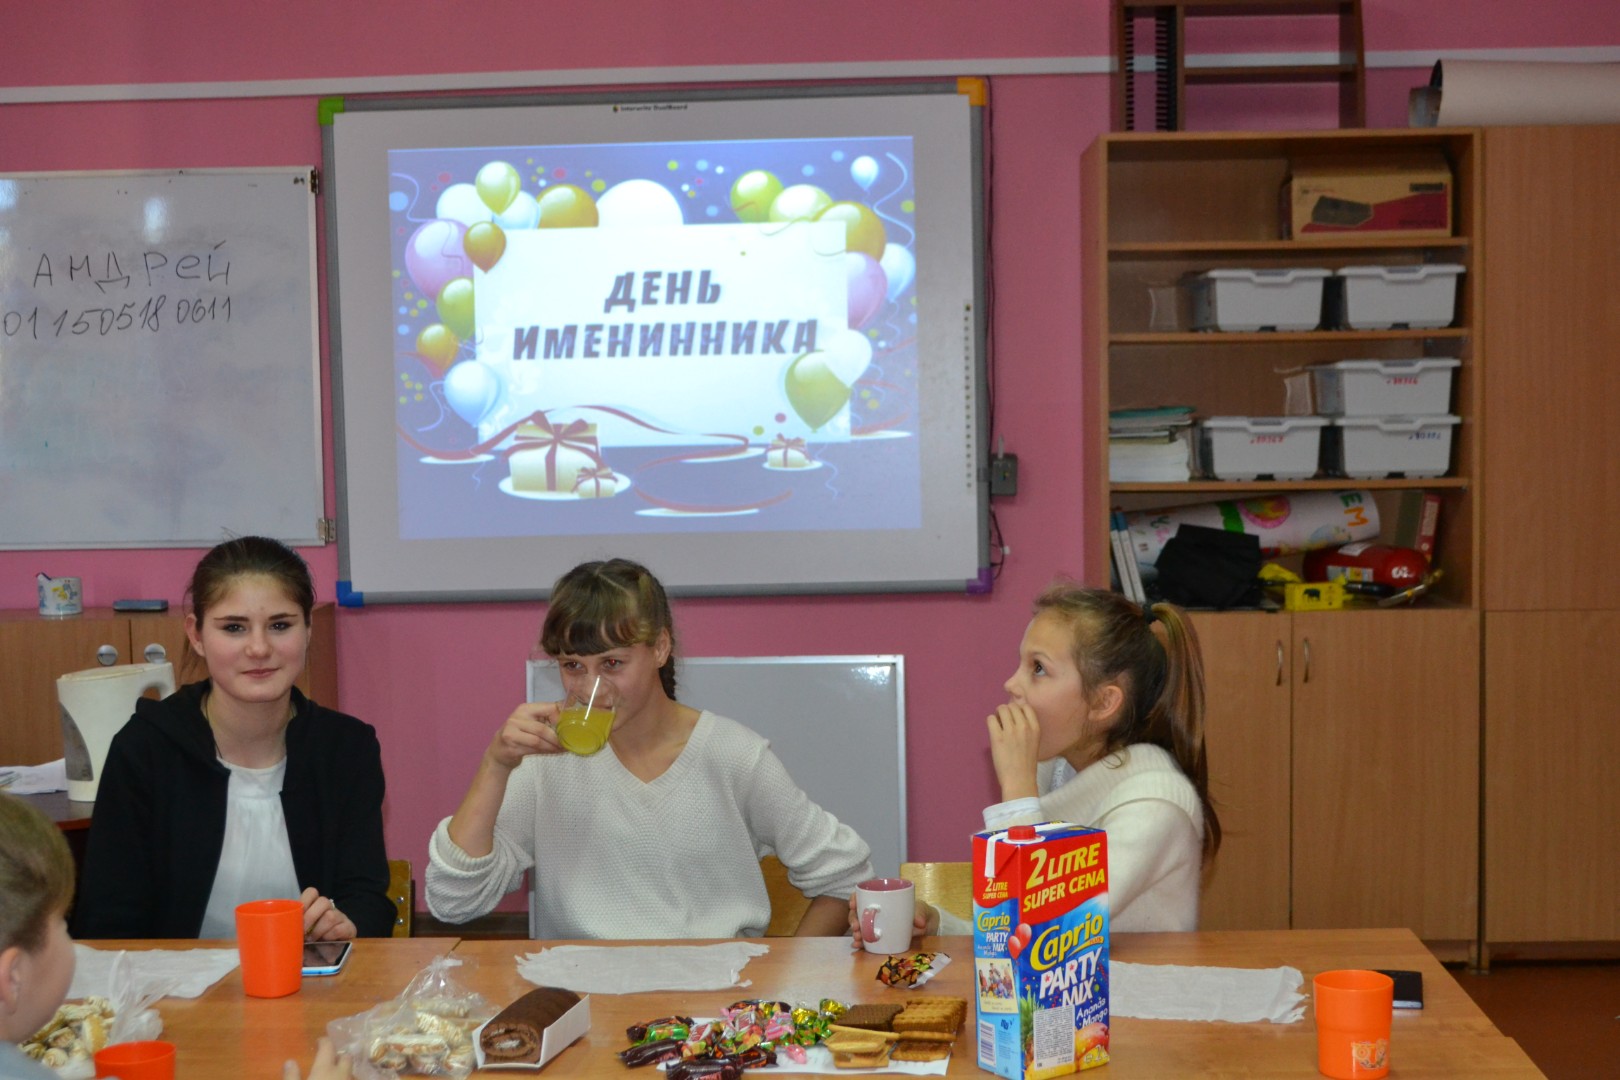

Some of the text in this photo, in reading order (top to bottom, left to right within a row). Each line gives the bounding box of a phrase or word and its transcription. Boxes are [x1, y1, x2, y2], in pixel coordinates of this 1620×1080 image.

[603, 270, 721, 313] ДЕНЬ
[513, 319, 818, 360] ИМЕНИННИКА
[1026, 843, 1100, 890] 2 LITRE
[984, 878, 1008, 892] 2 LITRE
[1023, 868, 1105, 912] SUPER CENA
[977, 911, 1010, 932] Caprio
[986, 932, 1008, 943] PARTY
[992, 943, 1006, 952] MIX
[1030, 912, 1103, 971] Caprio
[1039, 946, 1103, 999] PARTY
[1061, 976, 1093, 1008] MIX
[1082, 1008, 1108, 1028] Mango
